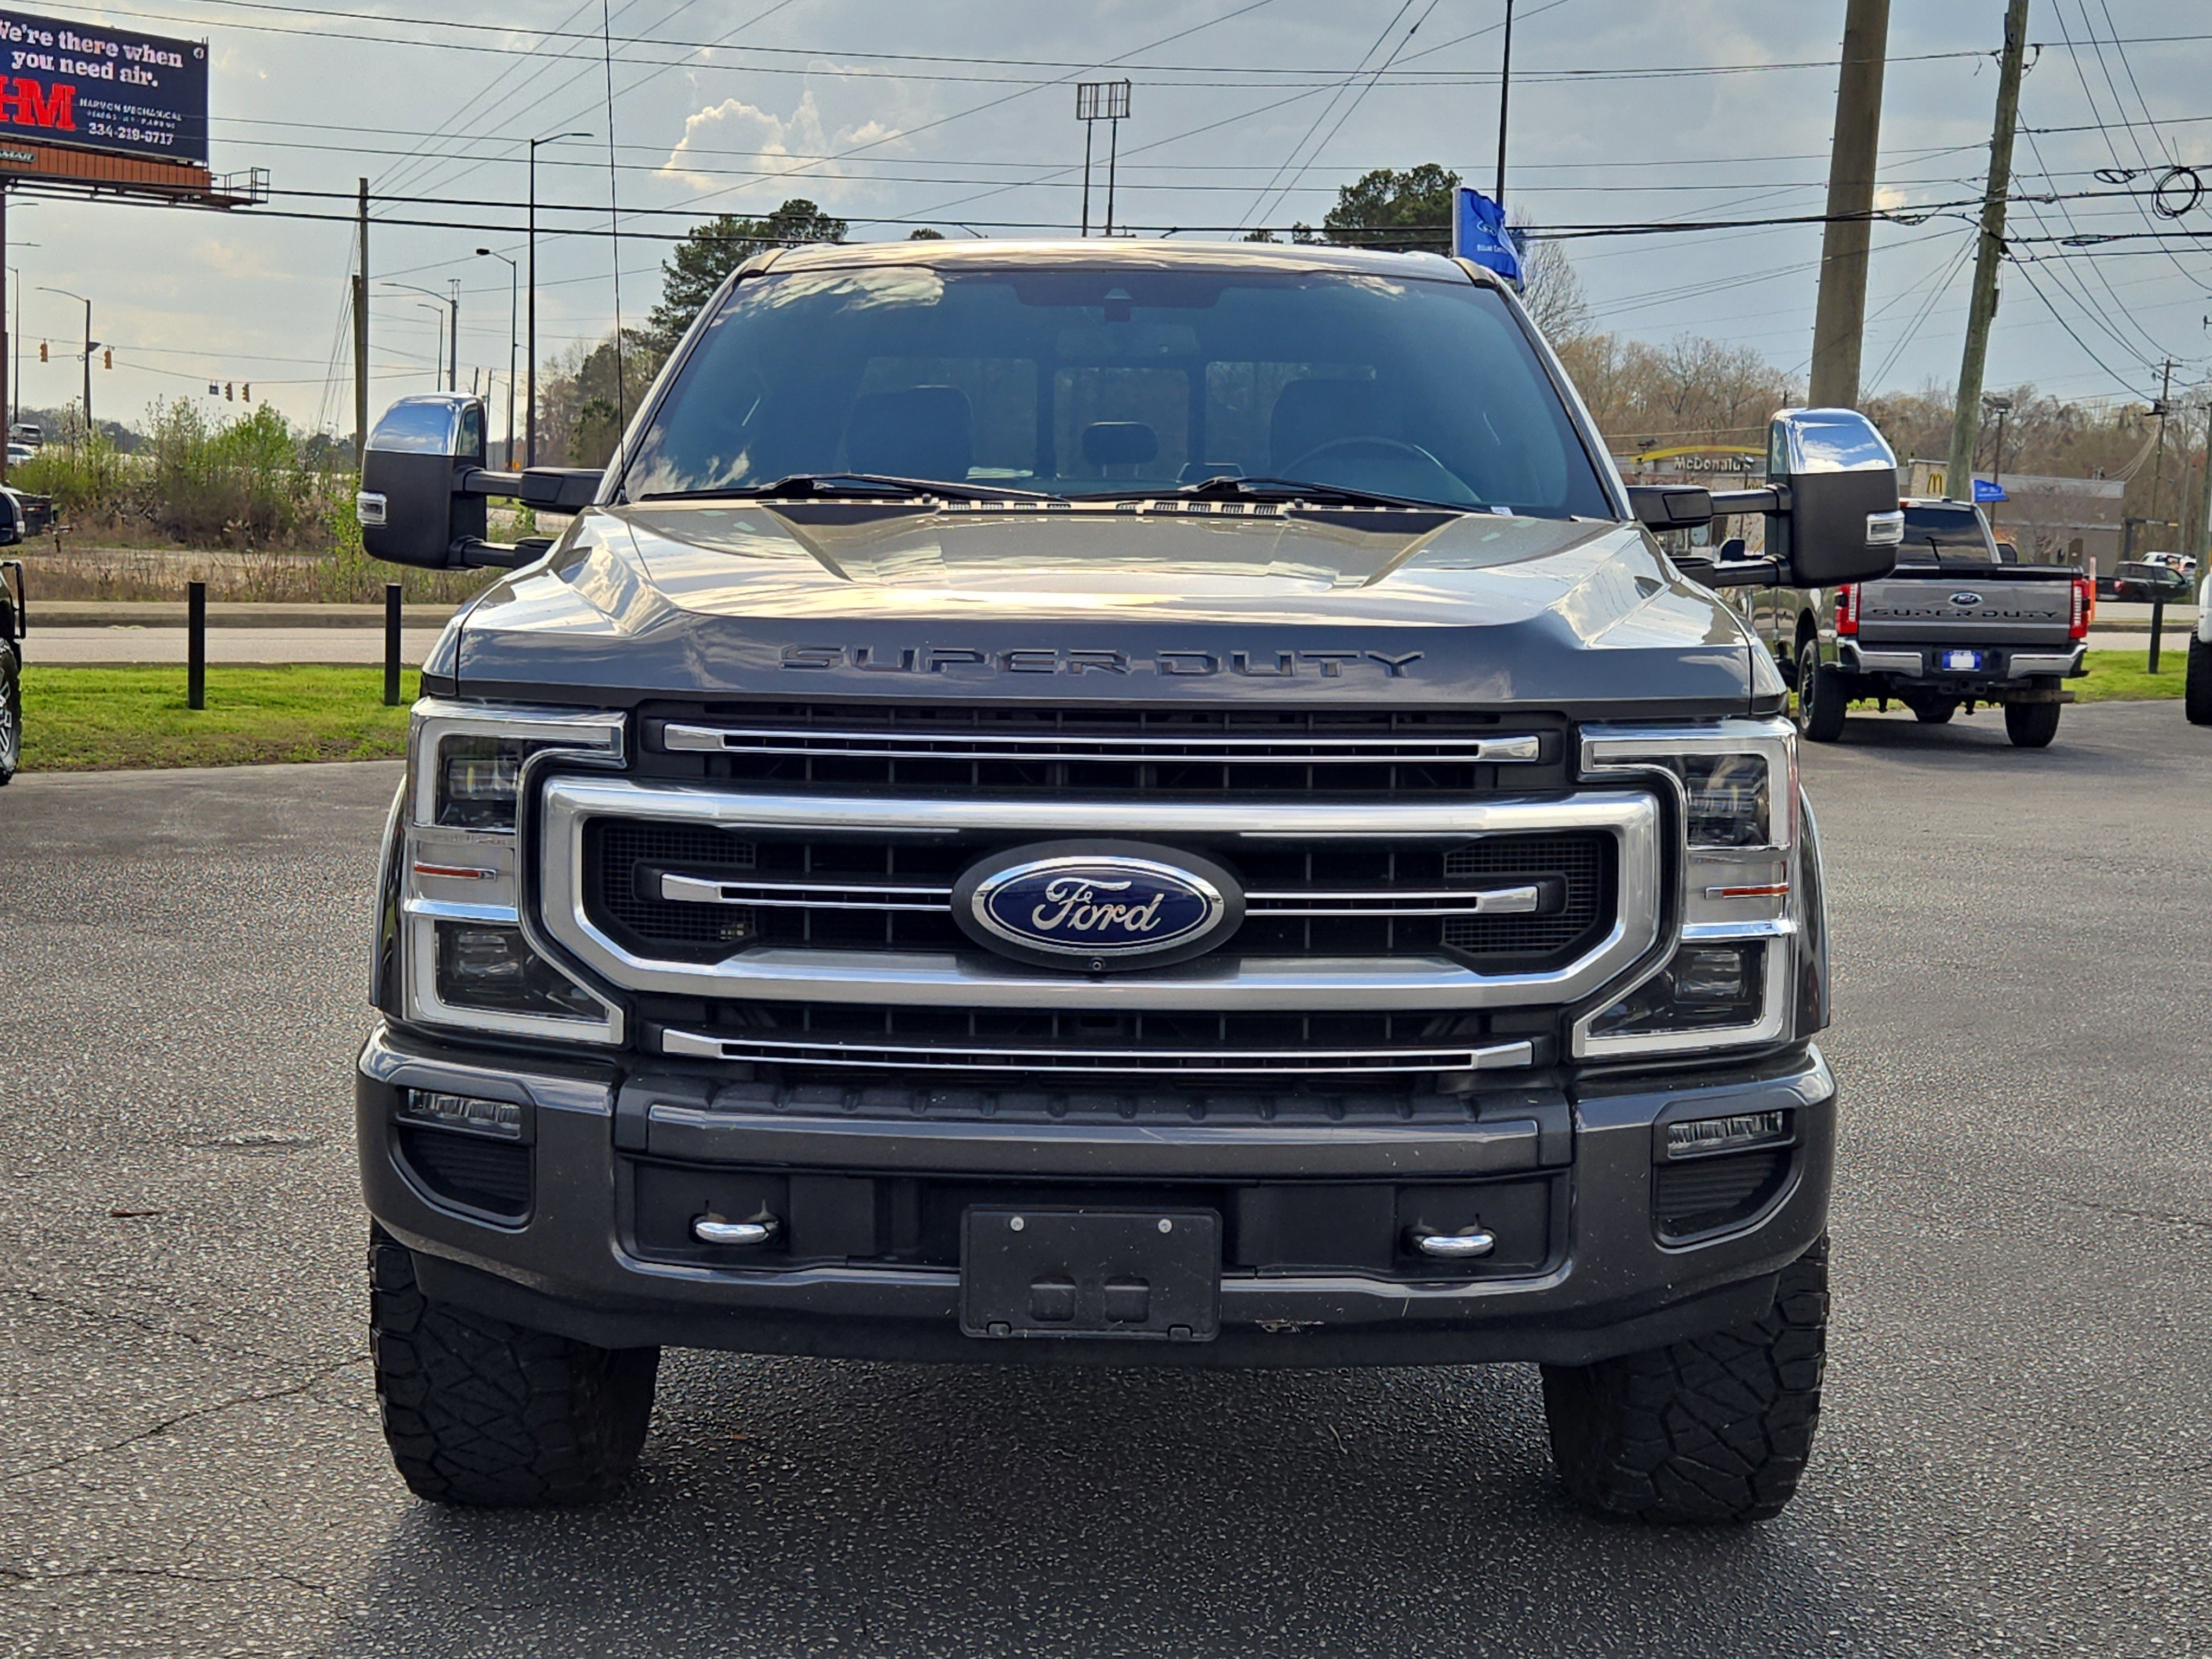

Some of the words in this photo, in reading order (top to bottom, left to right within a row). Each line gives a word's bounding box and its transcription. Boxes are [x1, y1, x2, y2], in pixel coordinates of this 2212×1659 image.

[58, 30, 119, 57] there
[123, 43, 183, 68] when
[11, 51, 54, 71] you
[60, 57, 114, 80] need
[120, 65, 158, 87] air.
[1675, 456, 1752, 472] McDonalds
[1982, 609, 2059, 619] DUTY
[779, 644, 1131, 677] SUPER
[1155, 650, 1425, 678] DUTY
[1032, 876, 1165, 932] Ford
